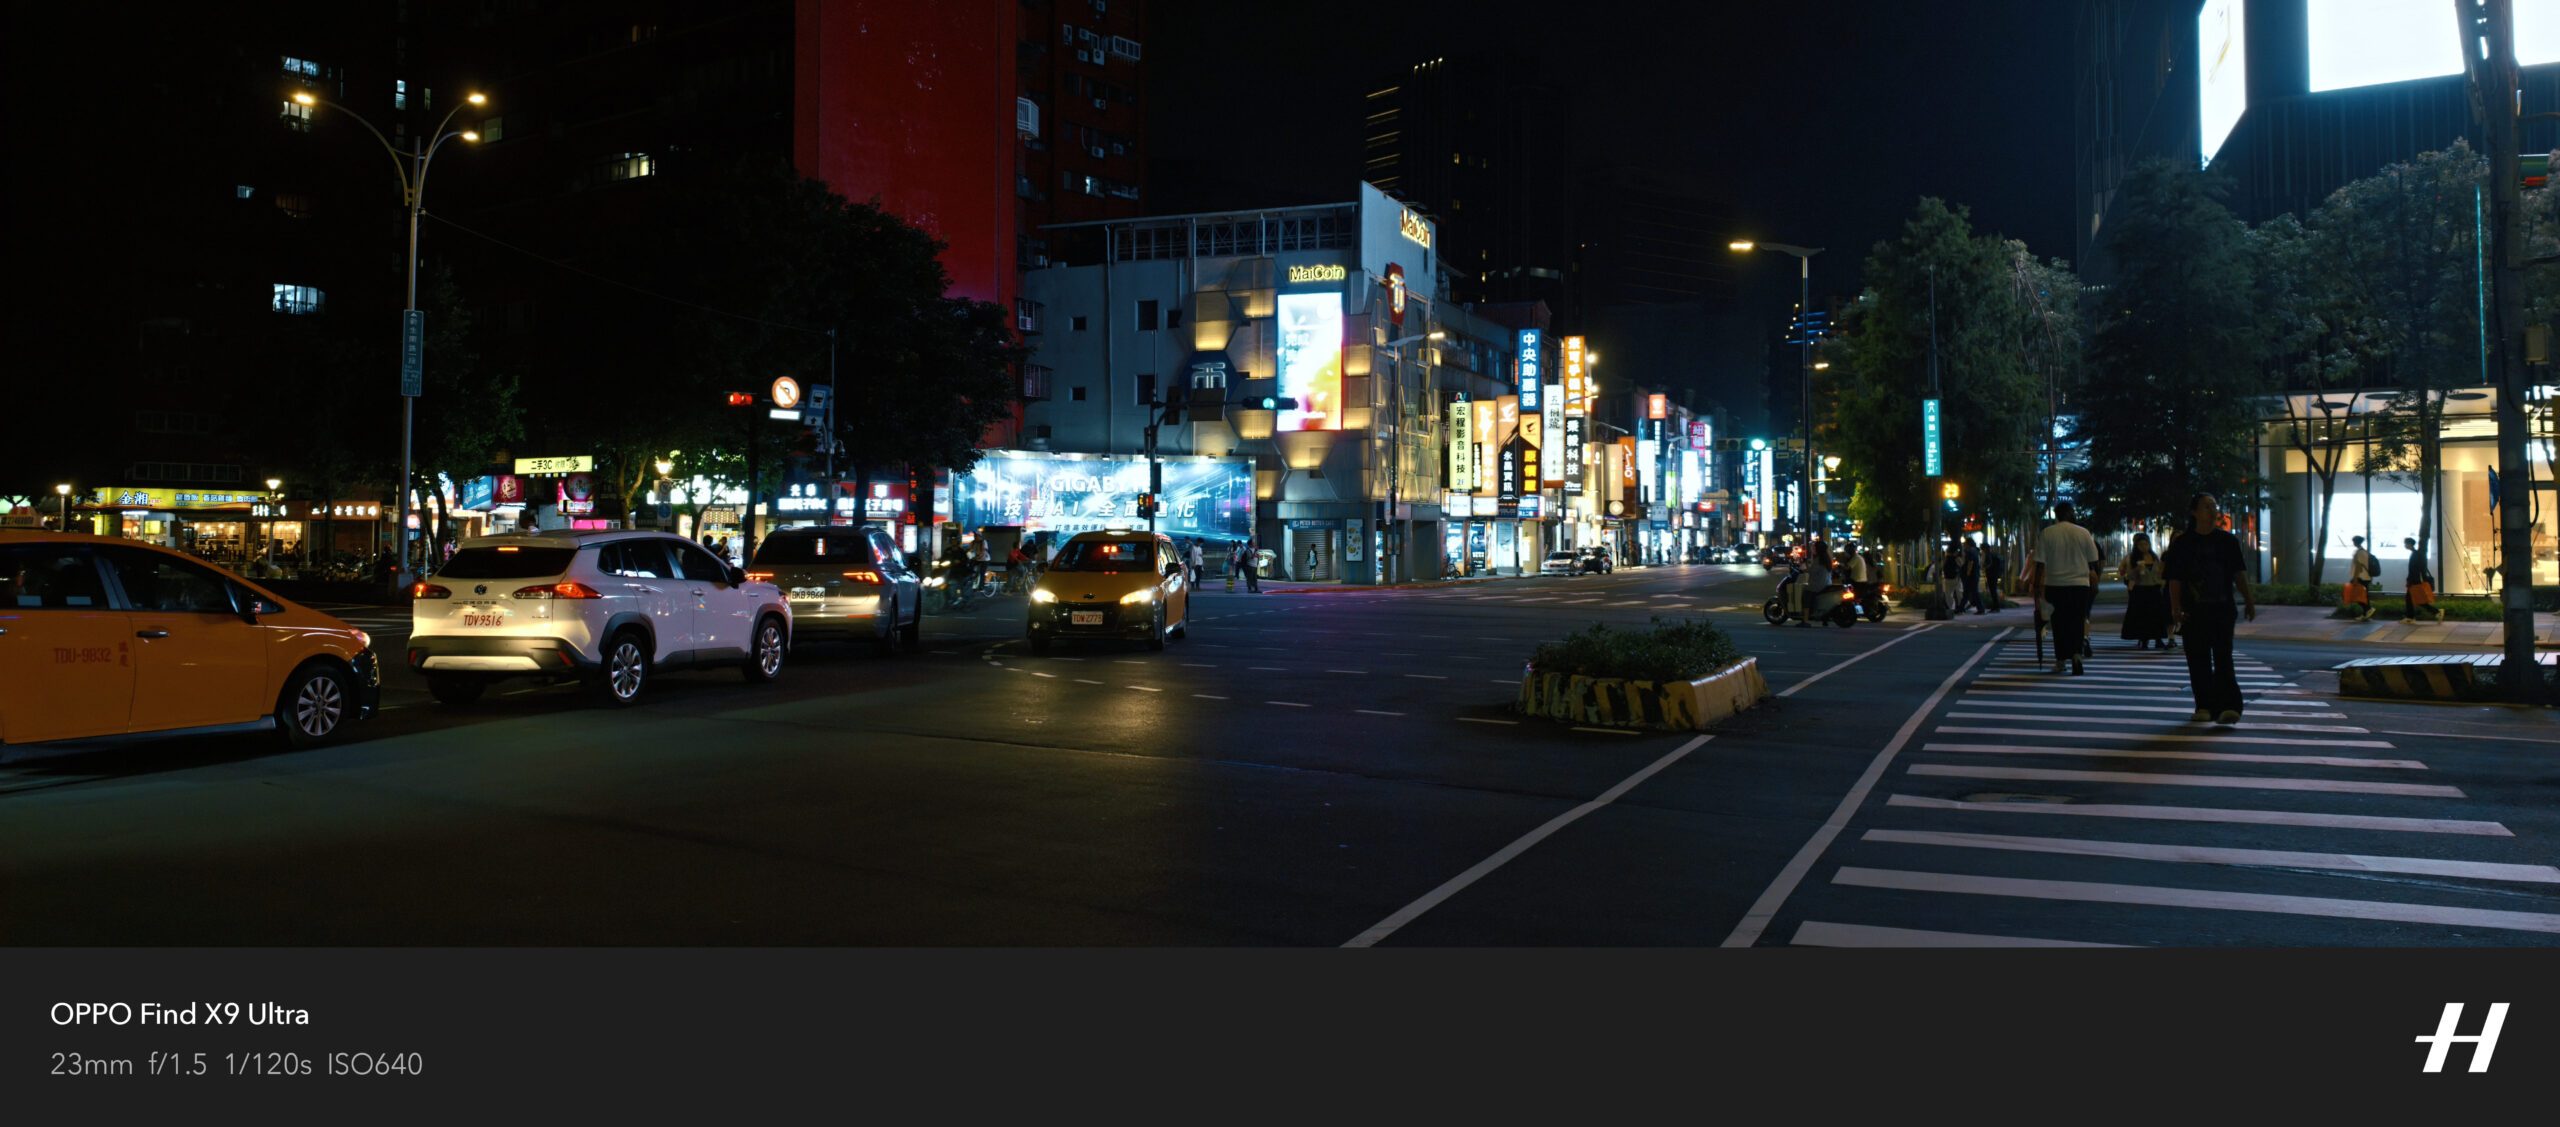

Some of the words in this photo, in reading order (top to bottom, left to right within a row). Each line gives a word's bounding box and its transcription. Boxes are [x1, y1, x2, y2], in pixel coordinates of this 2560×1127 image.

[1400, 209, 1431, 247] MaiCoin
[1290, 264, 1345, 282] MaiCoin
[1456, 406, 1466, 474] 宏程影音科技
[1050, 475, 1150, 493] GIGAB
